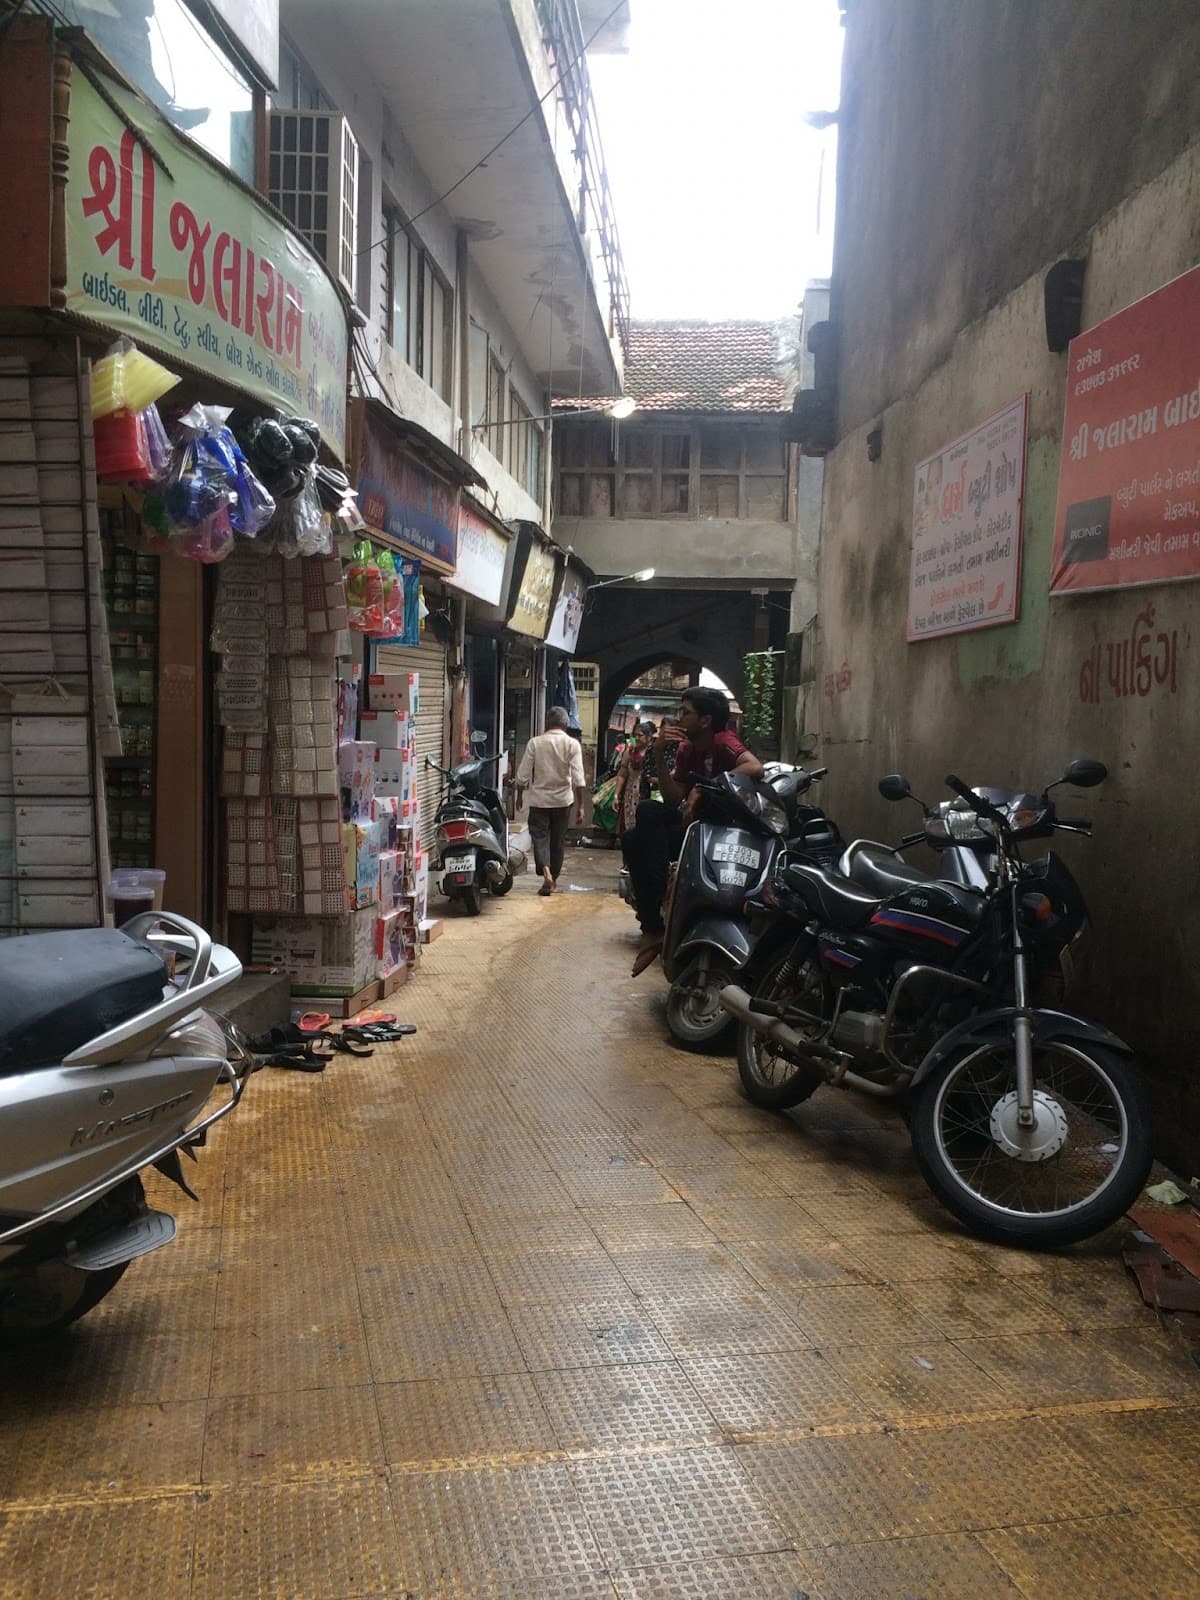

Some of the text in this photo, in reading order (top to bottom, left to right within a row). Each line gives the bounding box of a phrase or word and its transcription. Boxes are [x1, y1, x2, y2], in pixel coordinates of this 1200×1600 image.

[82, 127, 303, 370] શ્રી જલારામ
[1070, 421, 1089, 461] શ્રી
[1093, 405, 1158, 453] જલારામ
[728, 844, 753, 858] GJ03
